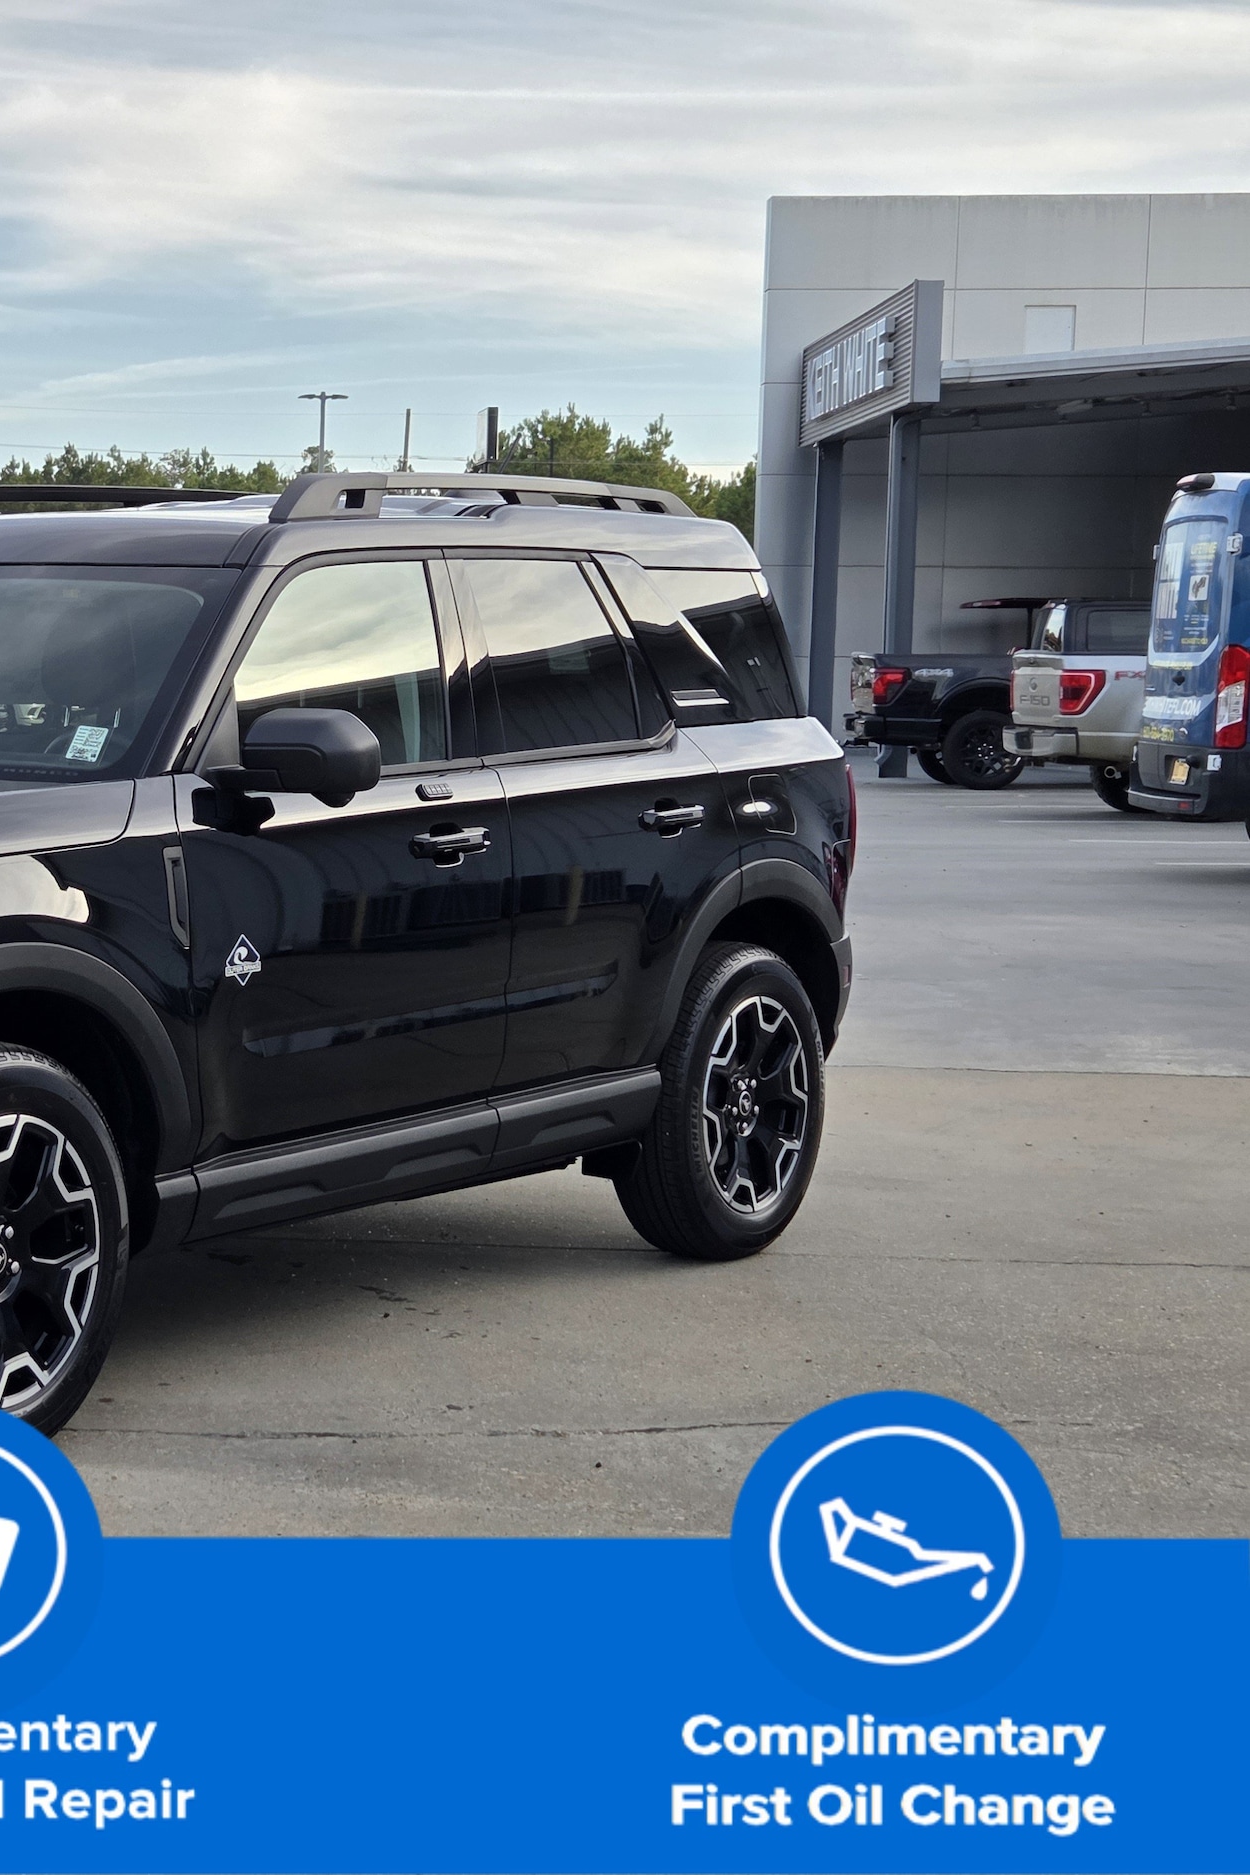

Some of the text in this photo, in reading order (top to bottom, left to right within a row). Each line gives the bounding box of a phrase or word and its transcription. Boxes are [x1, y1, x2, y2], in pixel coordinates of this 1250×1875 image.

[806, 316, 896, 422] KEITH WHITE
[1114, 670, 1147, 682] FX
[1019, 695, 1051, 707] F-150
[690, 1086, 703, 1173] MICHELIN
